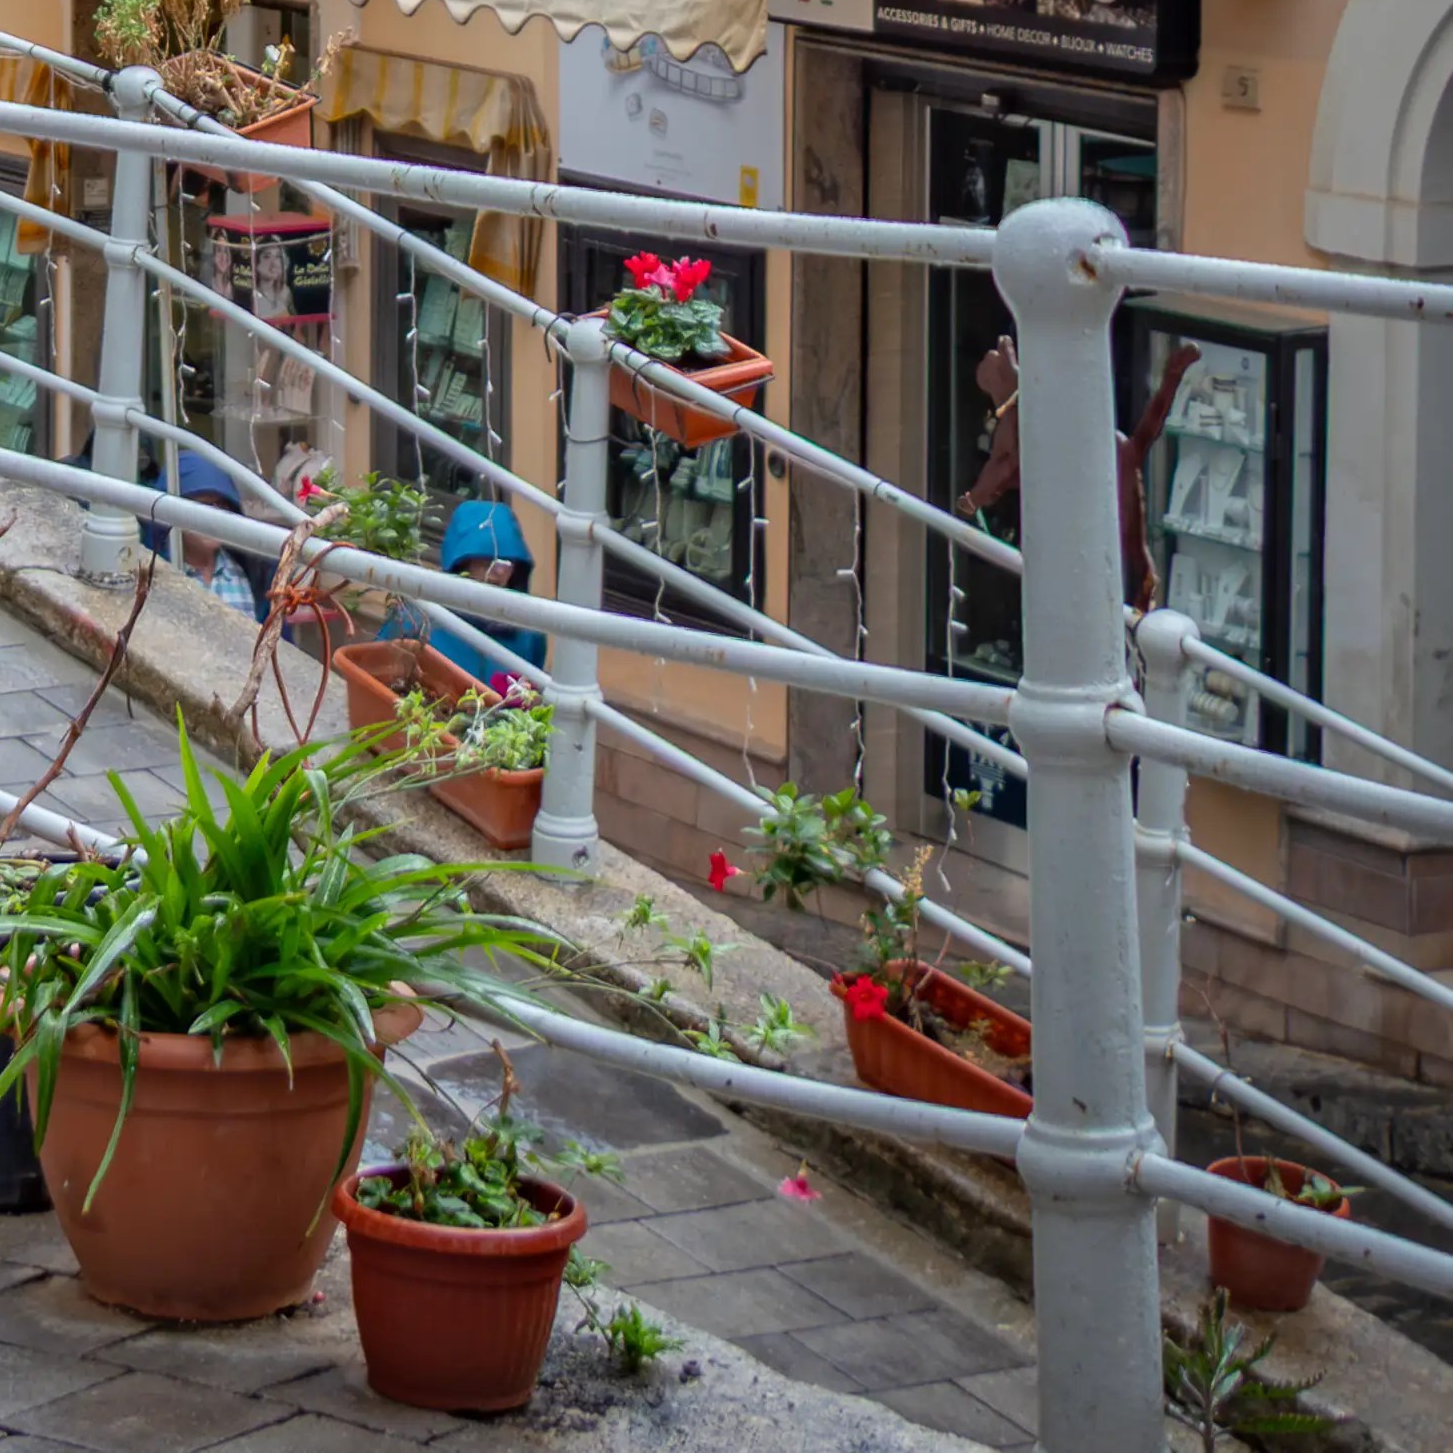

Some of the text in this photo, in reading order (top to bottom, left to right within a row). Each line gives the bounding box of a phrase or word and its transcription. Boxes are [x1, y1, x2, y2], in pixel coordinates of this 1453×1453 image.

[877, 7, 939, 28] ACCESSORIES
[951, 17, 977, 35] GIFTS
[986, 22, 1015, 41] HOME
[1017, 28, 1051, 46] DECOR
[1106, 41, 1154, 63] WATCHES
